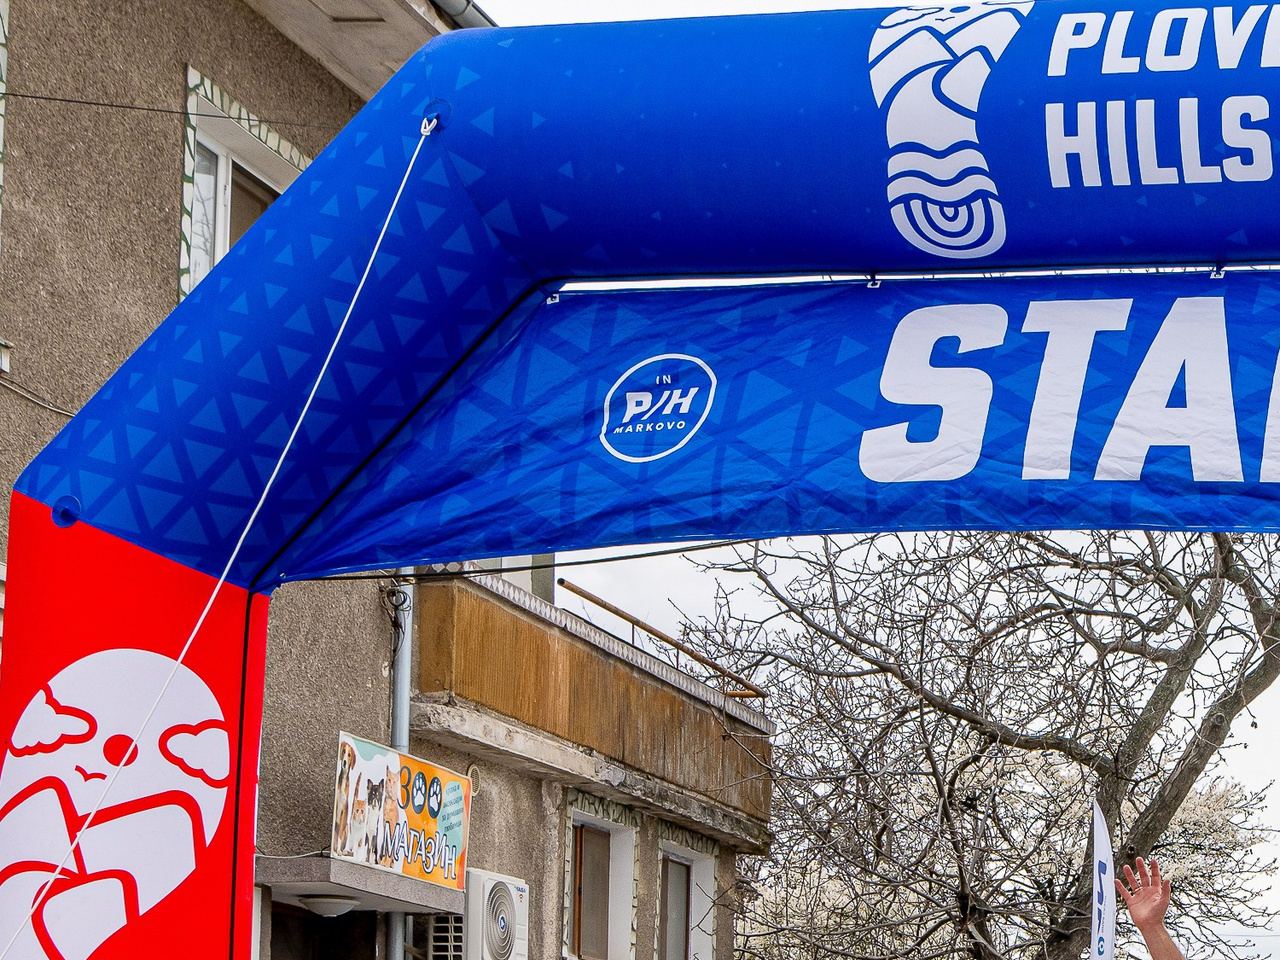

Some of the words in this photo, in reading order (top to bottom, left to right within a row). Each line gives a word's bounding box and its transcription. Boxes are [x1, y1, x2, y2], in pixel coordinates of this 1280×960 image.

[1045, 95, 1273, 188] HILLS
[655, 374, 672, 386] IN
[621, 386, 700, 424] P/H
[612, 419, 687, 435] MARKOVO
[382, 820, 457, 880] МАГАЗИН
